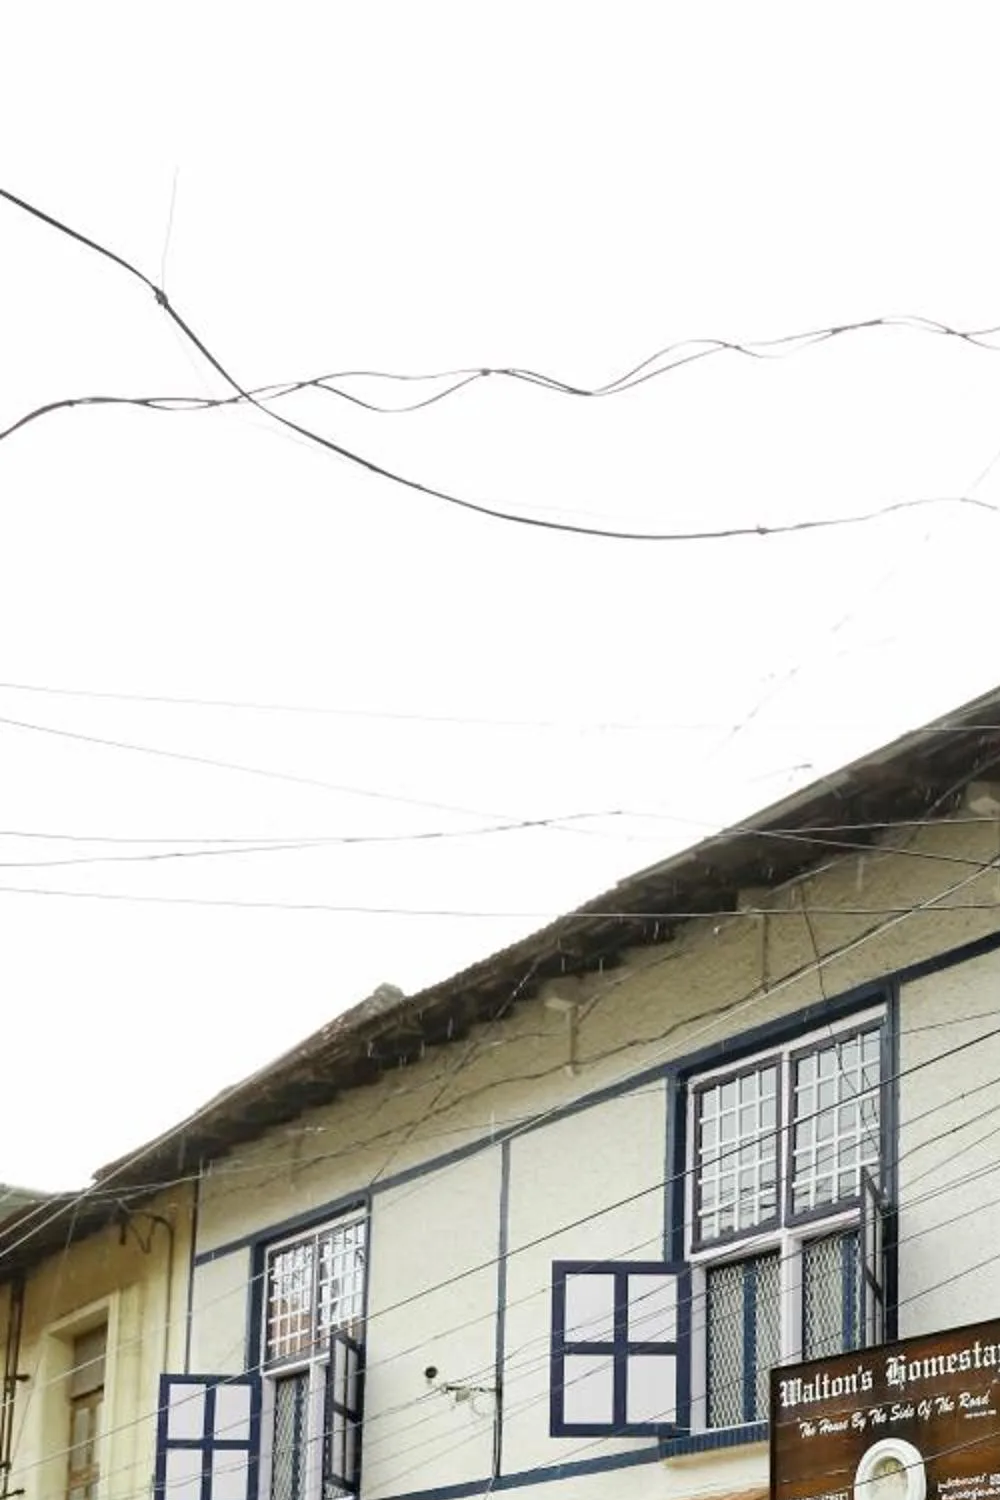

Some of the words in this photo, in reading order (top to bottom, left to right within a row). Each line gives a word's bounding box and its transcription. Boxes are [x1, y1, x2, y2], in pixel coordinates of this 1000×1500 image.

[780, 1366, 873, 1408] Walton's
[799, 1420, 816, 1439] The
[851, 1411, 866, 1432] By
[868, 1408, 886, 1428] The
[890, 1403, 914, 1421] Side
[918, 1399, 932, 1420] Of
[934, 1395, 954, 1416] The
[959, 1389, 990, 1409] Road
